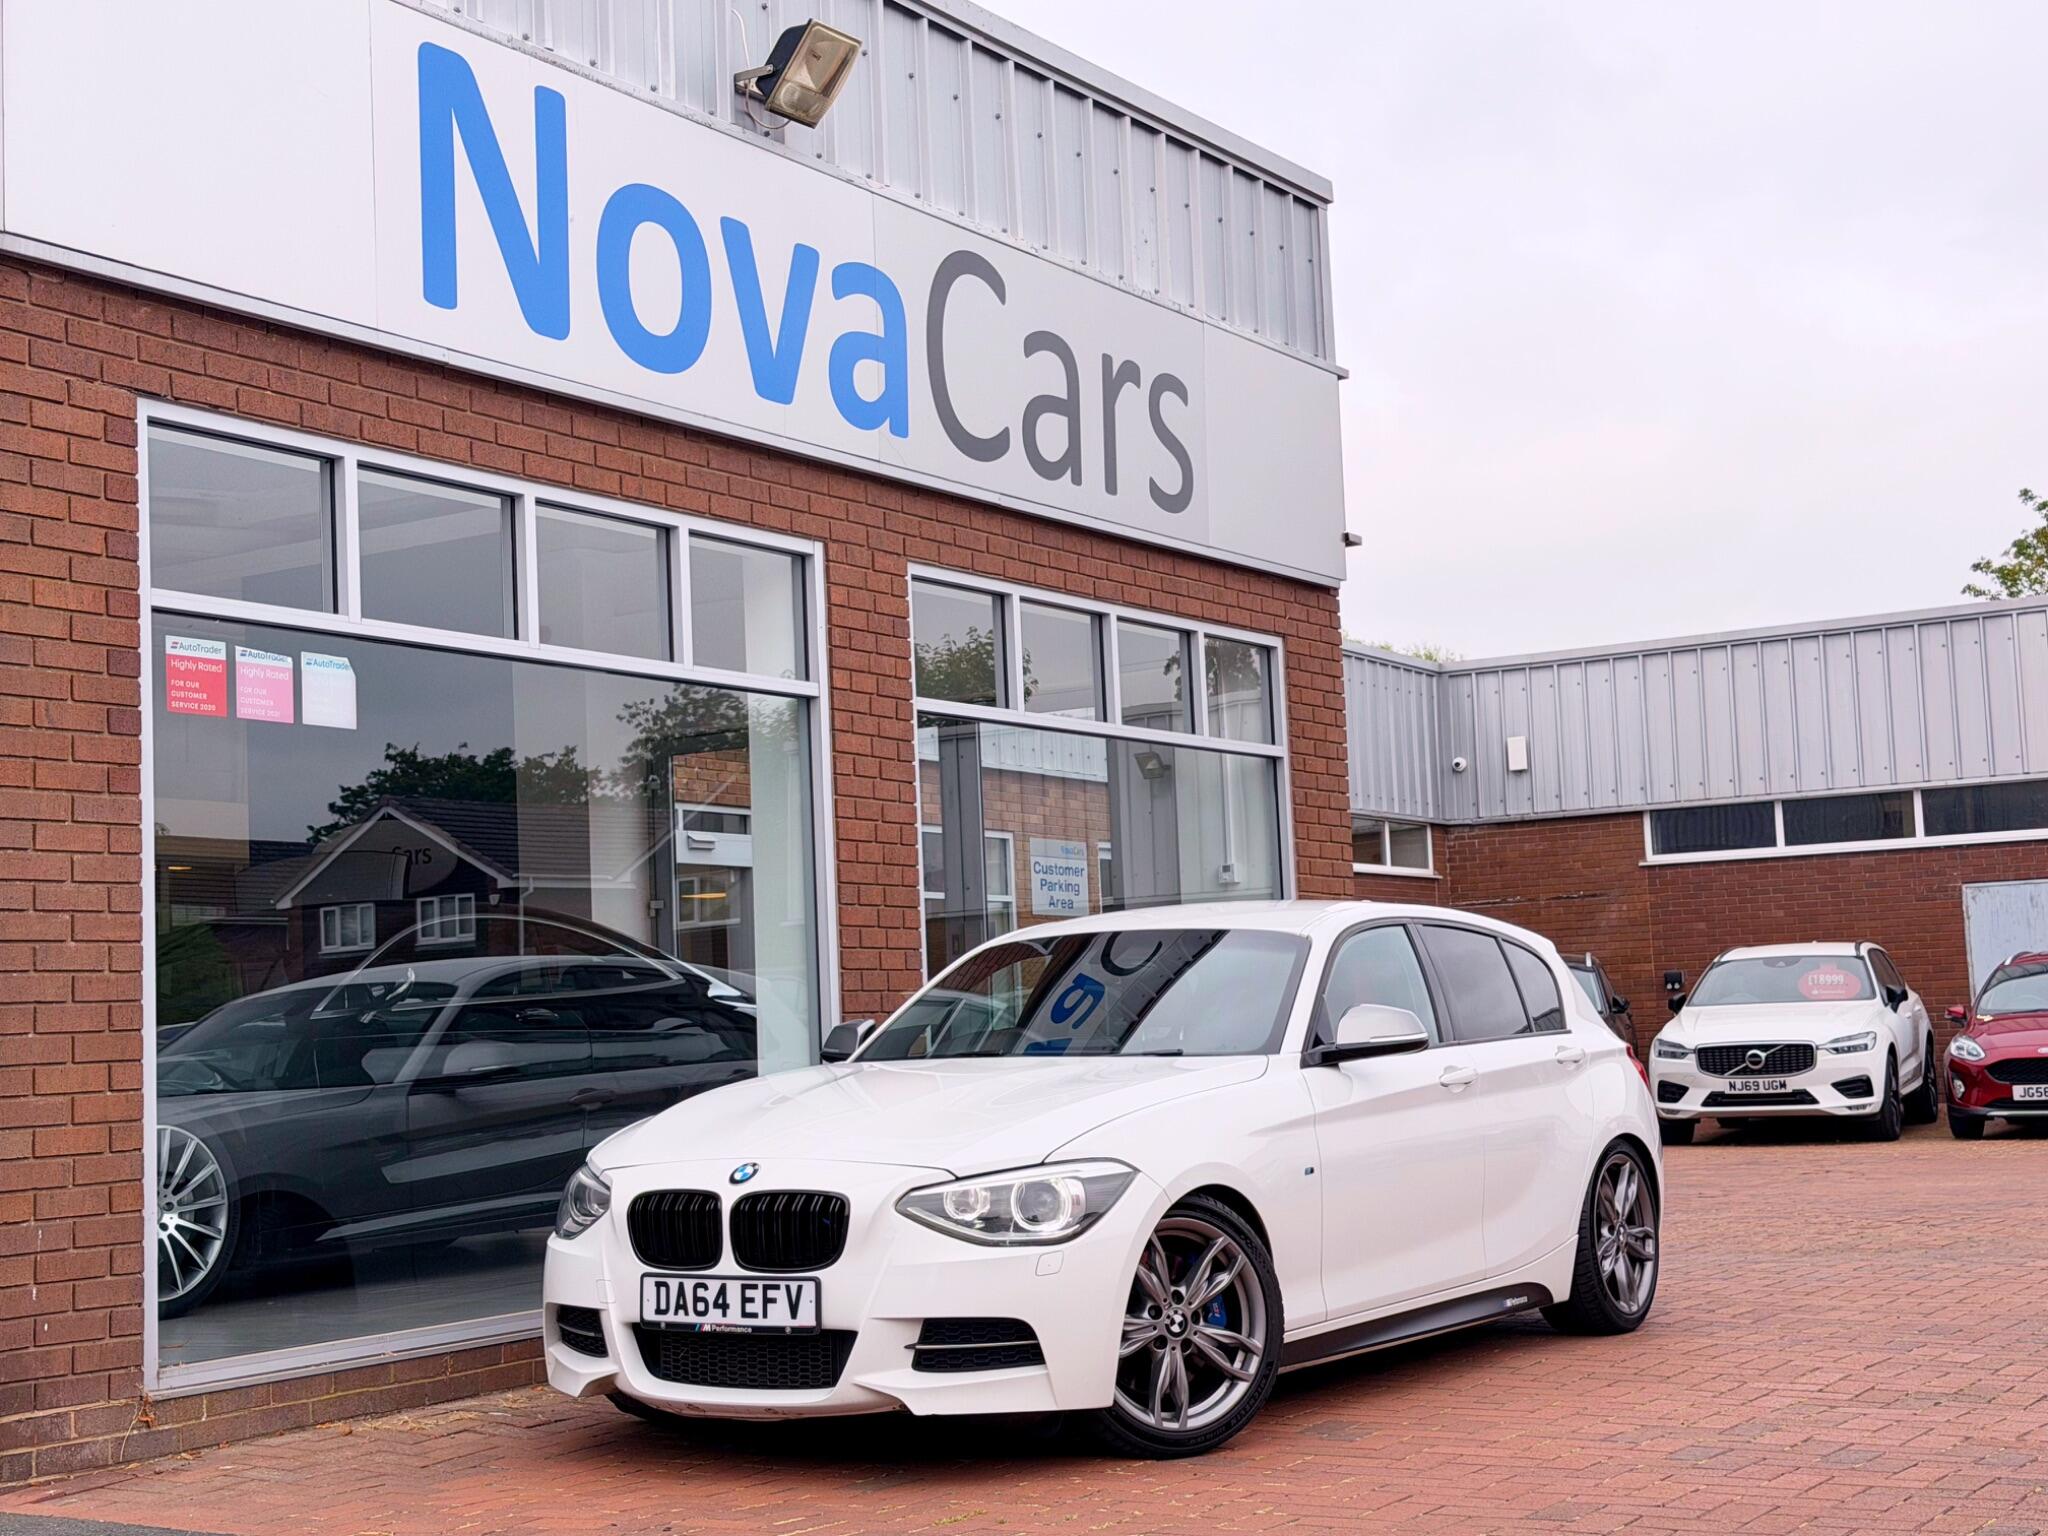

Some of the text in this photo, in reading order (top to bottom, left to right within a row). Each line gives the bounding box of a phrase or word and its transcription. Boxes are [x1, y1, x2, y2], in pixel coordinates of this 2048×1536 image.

[418, 42, 1193, 514] NovaCars
[179, 642, 222, 654] AutoTrader
[171, 659, 222, 672] Highly Rated
[240, 667, 288, 680] Highly Rated
[186, 681, 199, 689] OUR
[171, 691, 207, 699] CUSTOMER
[171, 701, 198, 709] SERVICE
[1034, 861, 1085, 877] Customer
[1040, 878, 1080, 896] Parking
[1049, 895, 1073, 909] Area
[1728, 1080, 1760, 1092] NJ69
[654, 1281, 803, 1320] DA64 EFV
[712, 1324, 752, 1333] Performance
